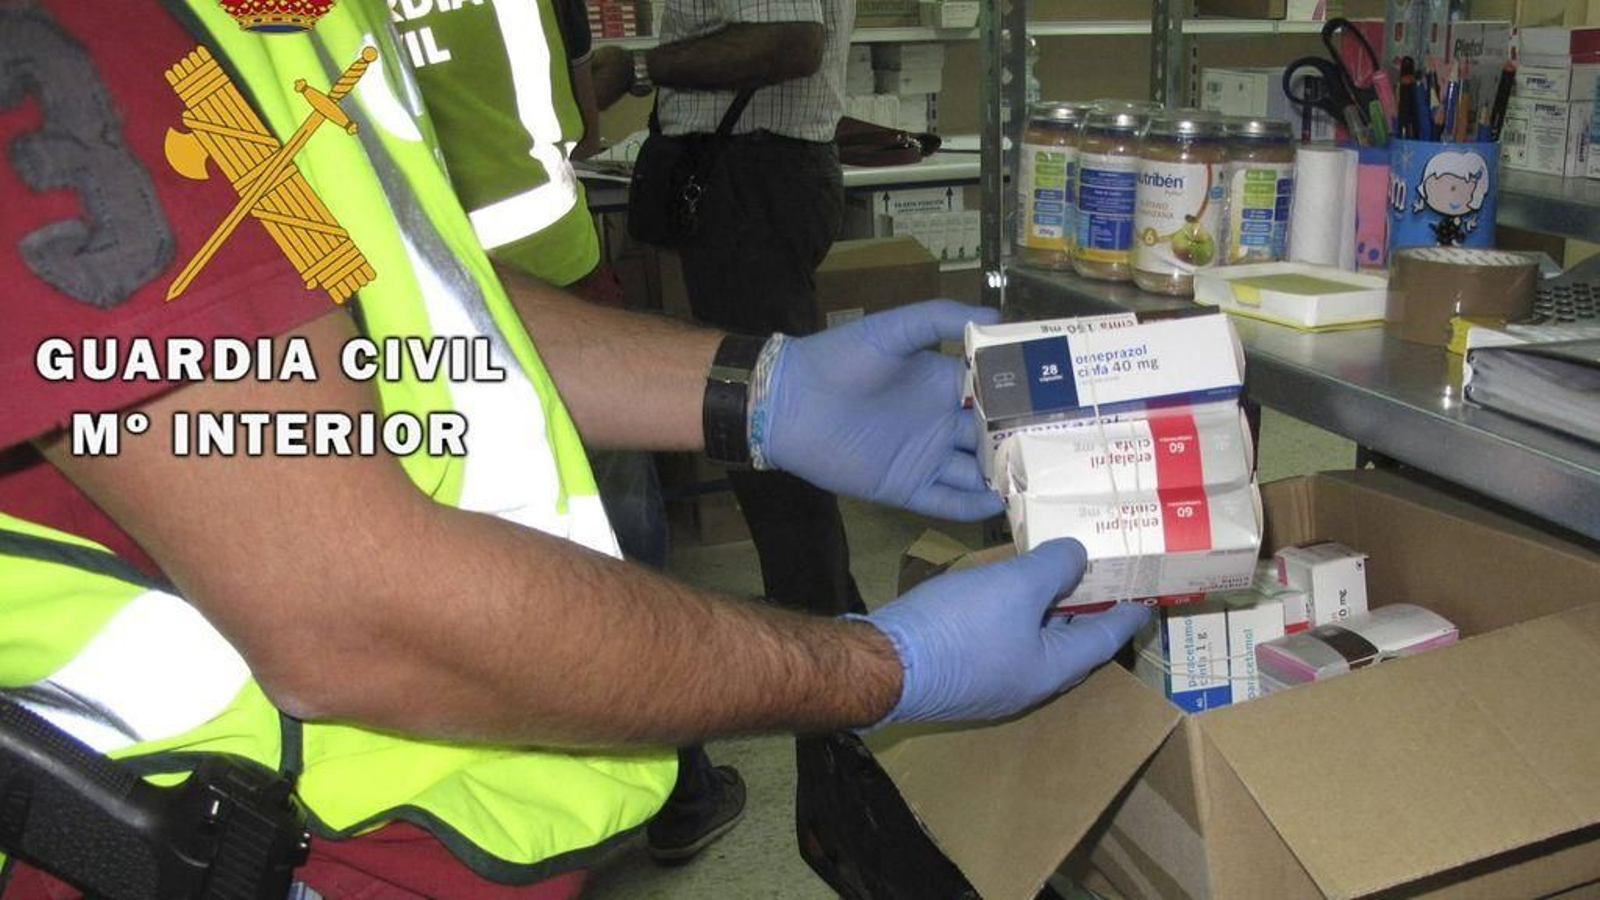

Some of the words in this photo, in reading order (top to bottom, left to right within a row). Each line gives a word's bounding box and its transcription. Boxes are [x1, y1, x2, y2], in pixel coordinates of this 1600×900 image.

[400, 26, 452, 68] IL
[1041, 364, 1059, 377] 28
[1113, 360, 1132, 373] 40
[1137, 358, 1160, 371] mg
[1169, 442, 1185, 454] 60
[1177, 506, 1193, 518] 60
